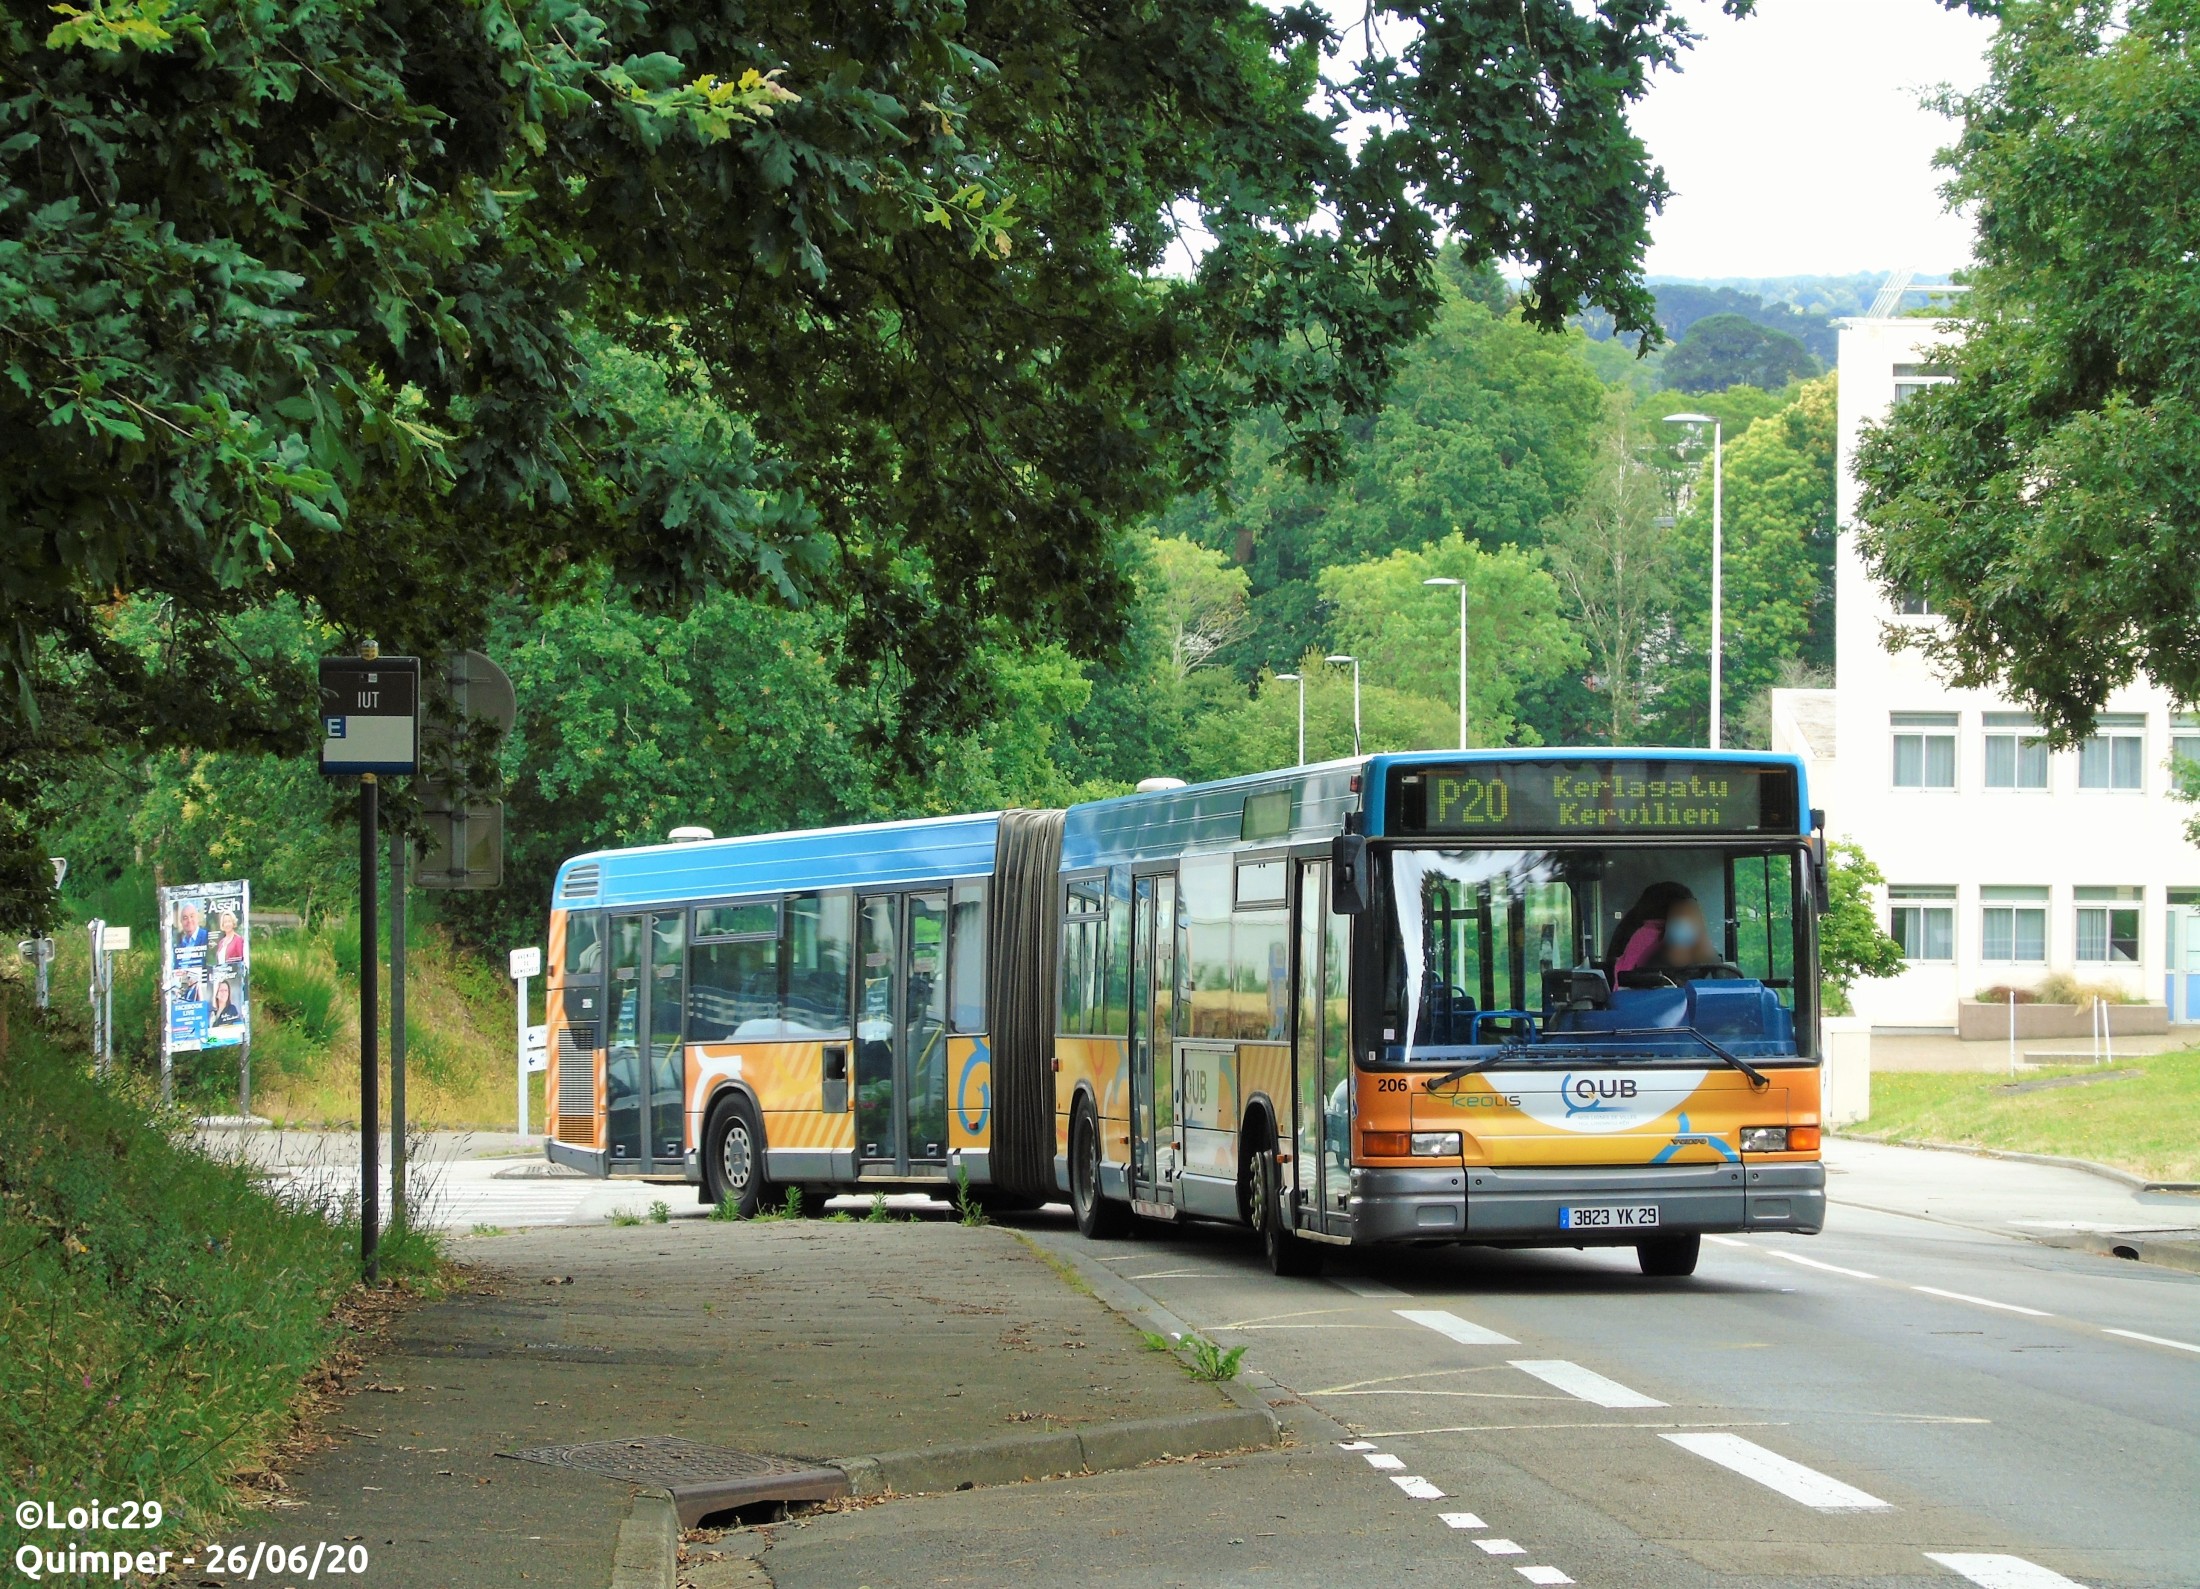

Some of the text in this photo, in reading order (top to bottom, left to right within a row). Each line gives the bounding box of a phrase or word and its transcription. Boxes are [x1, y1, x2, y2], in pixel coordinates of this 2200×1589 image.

[357, 691, 380, 709] IUT
[327, 718, 342, 737] E
[1553, 775, 1728, 798] Kerlagatu
[1438, 778, 1508, 823] P20
[1559, 802, 1720, 826] Kervilien
[1184, 1068, 1207, 1105] QUB
[1378, 1079, 1407, 1092] 206
[1576, 1079, 1638, 1099] QUB
[1574, 1209, 1610, 1226] 3823
[1617, 1208, 1634, 1225] YK
[1638, 1208, 1656, 1224] 29
